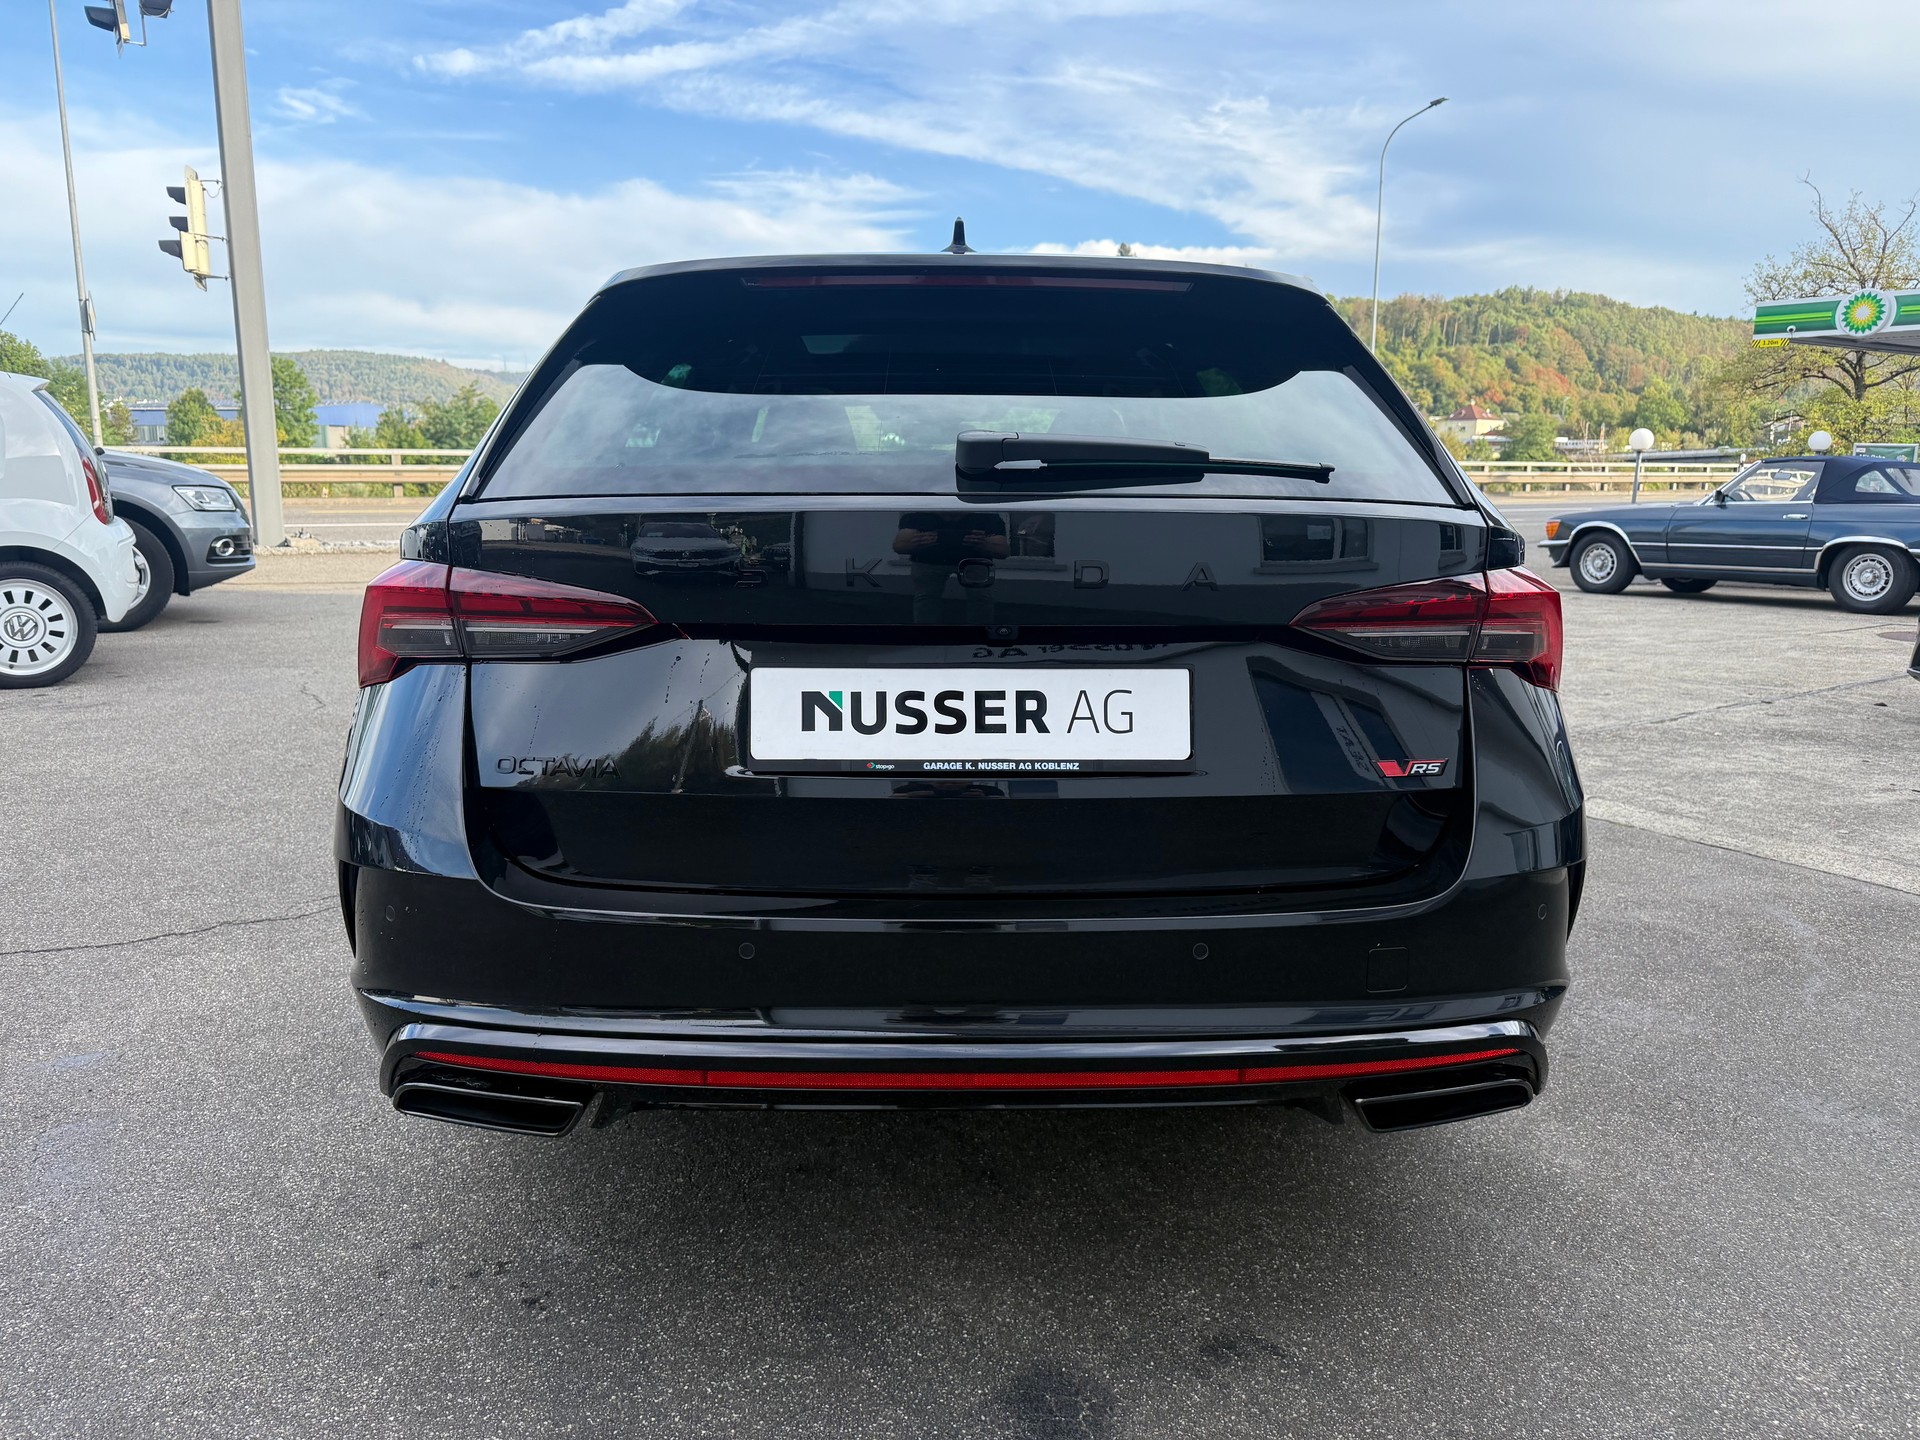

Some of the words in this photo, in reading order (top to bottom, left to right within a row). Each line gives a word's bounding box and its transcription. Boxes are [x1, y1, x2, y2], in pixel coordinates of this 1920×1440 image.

[801, 690, 1050, 735] NUSSER
[1066, 689, 1133, 734] AG
[496, 756, 621, 778] OCTAVIA
[923, 762, 963, 770] GARAGE
[965, 762, 975, 770] K.
[978, 762, 1016, 770] NUSSER
[1018, 762, 1032, 770] AG
[1034, 762, 1079, 770] KOBLENZ
